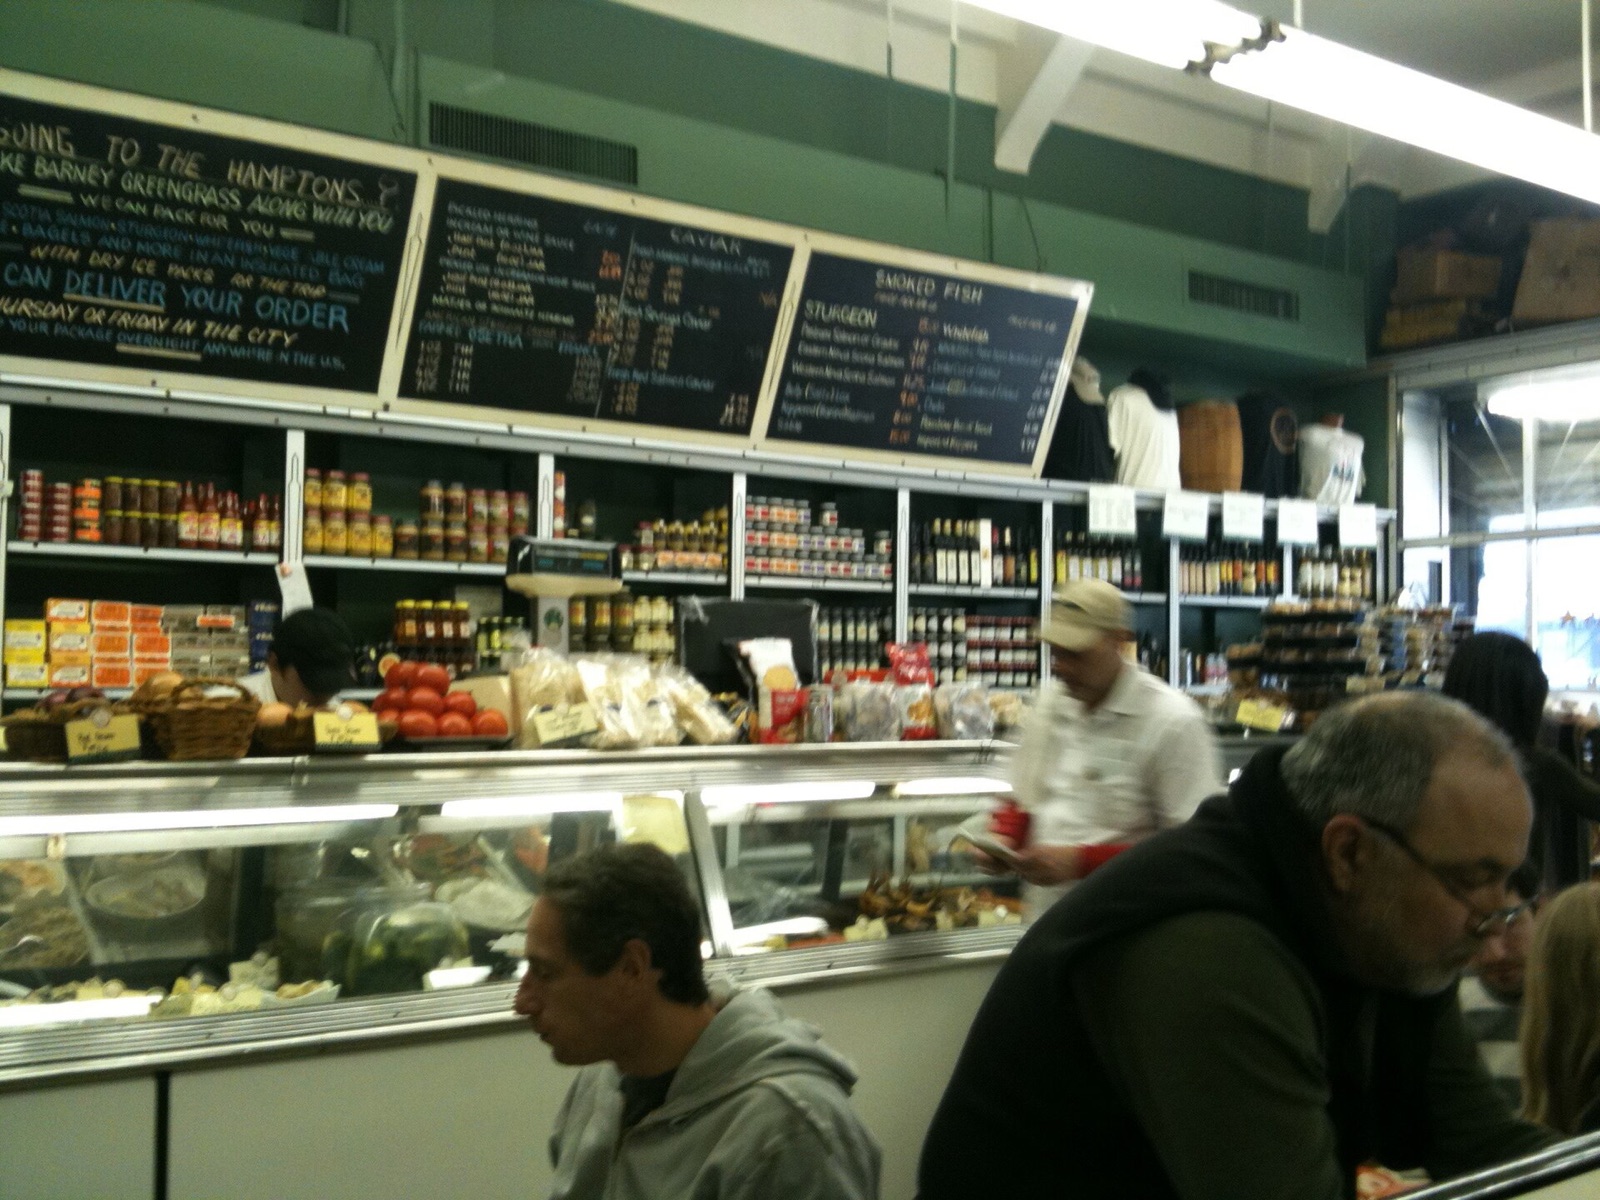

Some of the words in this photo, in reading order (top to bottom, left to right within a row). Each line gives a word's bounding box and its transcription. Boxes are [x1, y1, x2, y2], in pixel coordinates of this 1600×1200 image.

[106, 134, 140, 167] TO
[157, 142, 204, 179] THE
[34, 154, 115, 188] BARNEY
[121, 170, 242, 212] GREENGRASS
[248, 194, 309, 221] ALONG
[312, 201, 359, 228] WITH
[357, 209, 394, 235] YOU
[115, 196, 148, 216] CAN
[153, 202, 196, 225] PACK
[200, 210, 230, 231] FOR
[240, 218, 276, 239] YOU
[88, 250, 127, 271] DRY
[98, 235, 132, 251] AND
[136, 242, 182, 260] MORE
[669, 227, 742, 257] CAVIAR
[4, 262, 52, 290] CAN
[65, 268, 167, 310] DELIVER
[181, 285, 244, 320] YOUR
[255, 295, 351, 336] ORDER
[874, 267, 936, 298] SMOKED
[944, 280, 984, 306] FISH
[83, 306, 107, 327] OR
[107, 309, 171, 333] FRIDAY
[172, 317, 197, 337] IN
[202, 320, 243, 343] THE
[247, 326, 300, 349] CITY
[804, 298, 878, 330] STURGEON
[9, 318, 50, 335] YOUR
[54, 322, 114, 343] PACKAGE
[117, 331, 200, 352] OVERNIGHT
